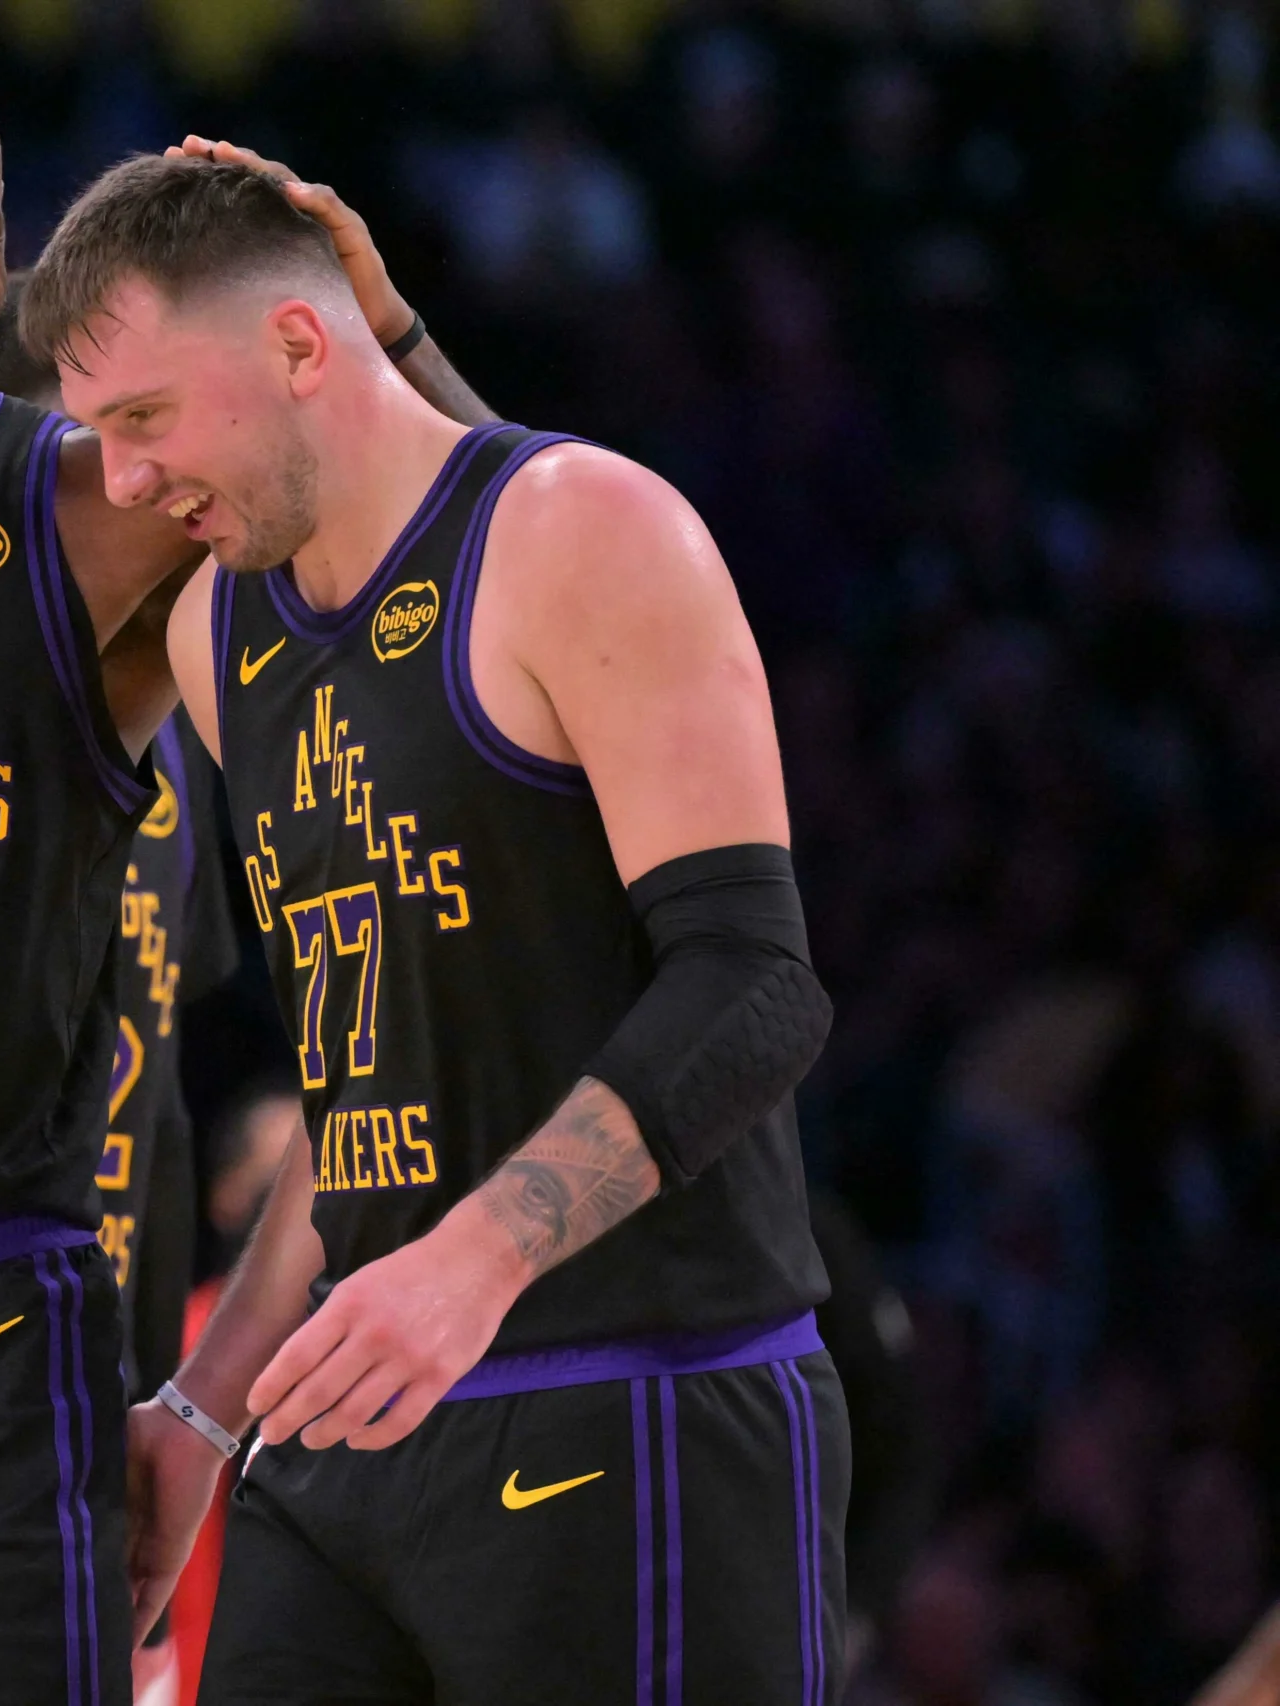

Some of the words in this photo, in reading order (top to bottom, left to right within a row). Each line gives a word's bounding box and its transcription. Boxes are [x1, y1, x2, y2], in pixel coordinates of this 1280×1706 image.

[378, 601, 435, 634] bibigo
[244, 810, 282, 933] OS
[293, 683, 471, 931] ANGELES
[280, 880, 382, 1090] 77
